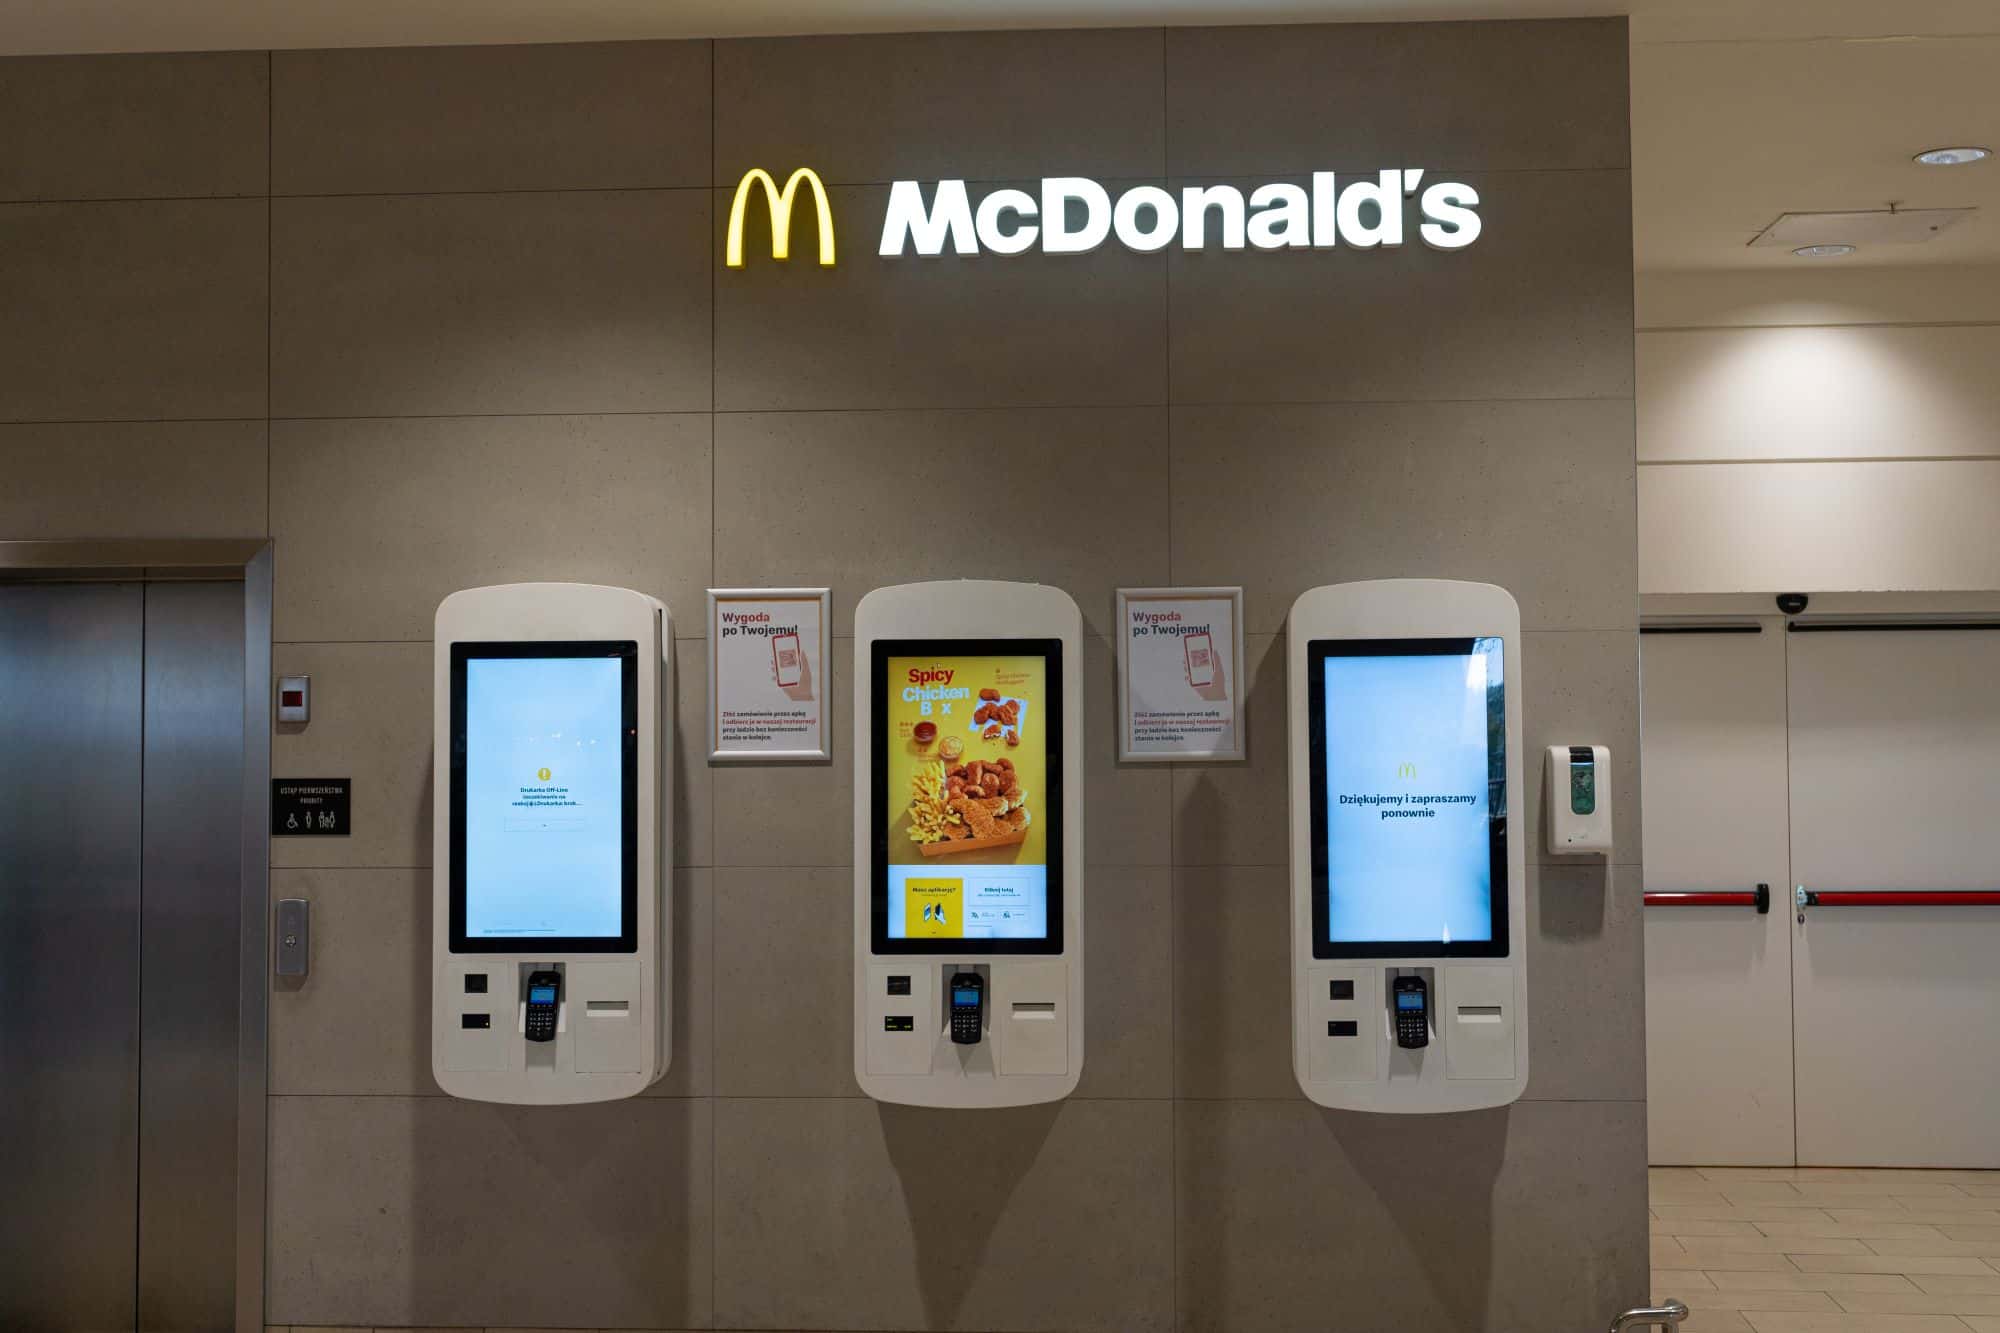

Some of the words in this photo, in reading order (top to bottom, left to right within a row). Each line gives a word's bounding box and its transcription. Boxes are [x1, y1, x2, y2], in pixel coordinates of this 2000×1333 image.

[879, 168, 1483, 257] McDonald's
[722, 612, 770, 625] Wygoda
[1132, 611, 1182, 624] Wygoda
[722, 626, 738, 638] po
[740, 624, 798, 637] Twojemu!
[1132, 626, 1148, 638] po
[1151, 623, 1210, 637] Twojemu!
[908, 667, 955, 686] Spicy
[902, 685, 970, 702] Chicken
[1339, 794, 1403, 807] Dziękujemy
[1405, 793, 1409, 804] i
[1411, 794, 1477, 806] zapraszamy
[1381, 807, 1436, 820] ponownie
